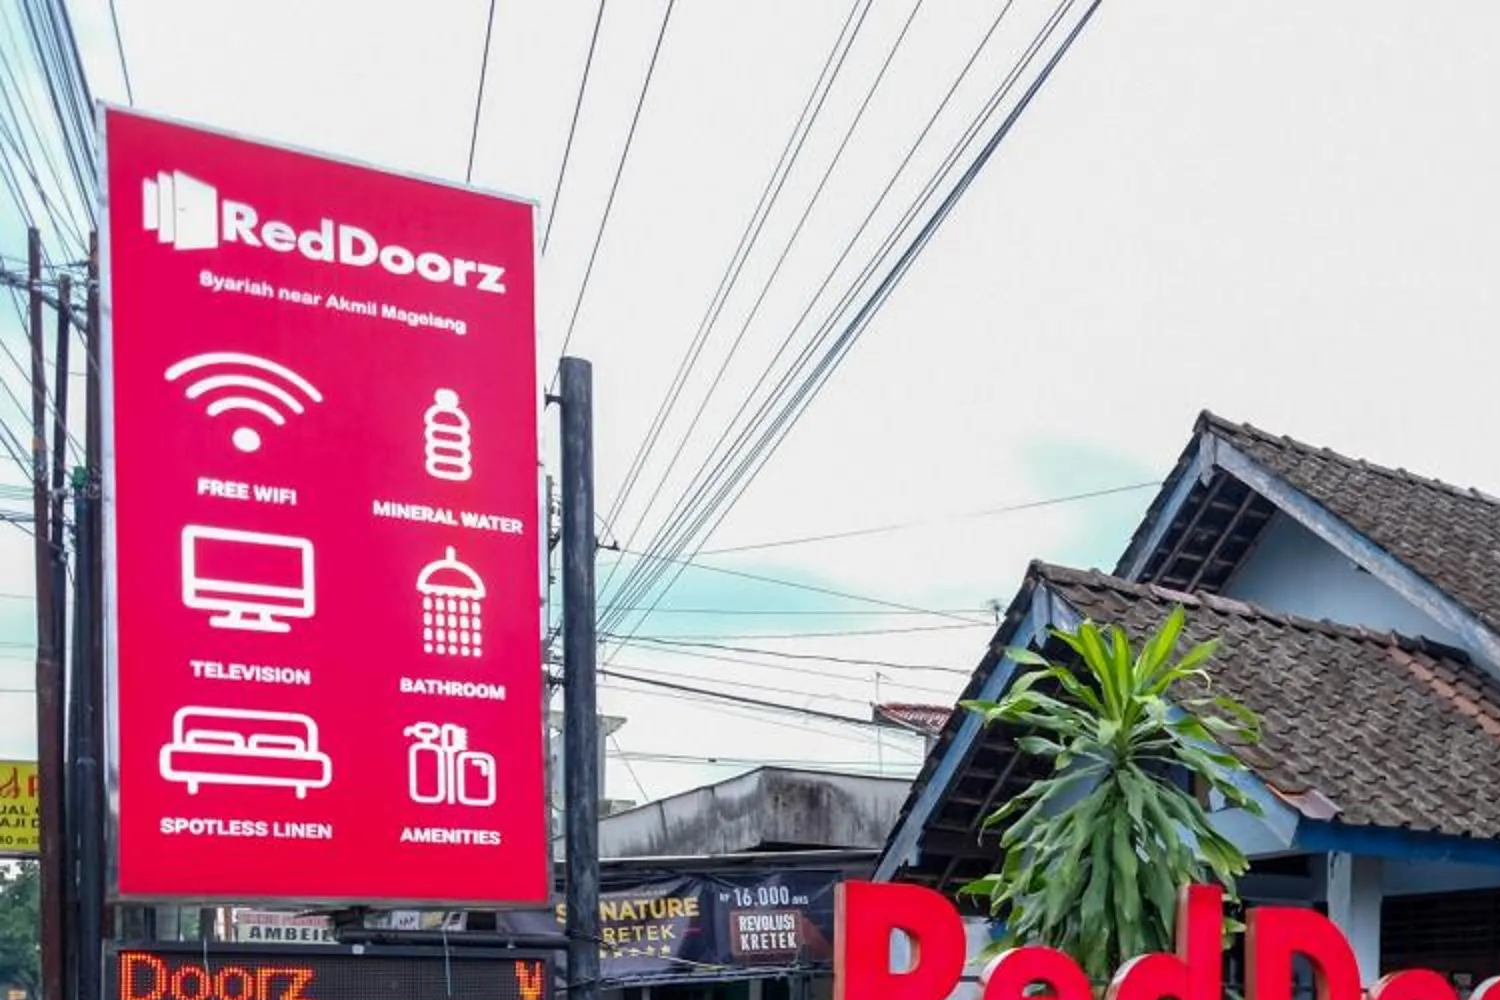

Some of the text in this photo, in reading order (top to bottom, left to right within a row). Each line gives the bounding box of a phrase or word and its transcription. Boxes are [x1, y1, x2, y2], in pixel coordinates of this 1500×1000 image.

[222, 199, 507, 294] RedDoorz
[199, 269, 467, 336] Syariah near Akmil Magelang
[197, 478, 298, 506] FREE WIFI
[372, 501, 524, 535] MINERAL WATER
[190, 660, 312, 686] TELEVISION
[400, 677, 507, 701] BATHROOM
[160, 817, 333, 841] SPOTLESS LINEN
[400, 828, 502, 846] AMENITIES
[602, 923, 677, 947] RETEK
[738, 913, 795, 933] REVOLUSI
[740, 931, 798, 951] KRETEK
